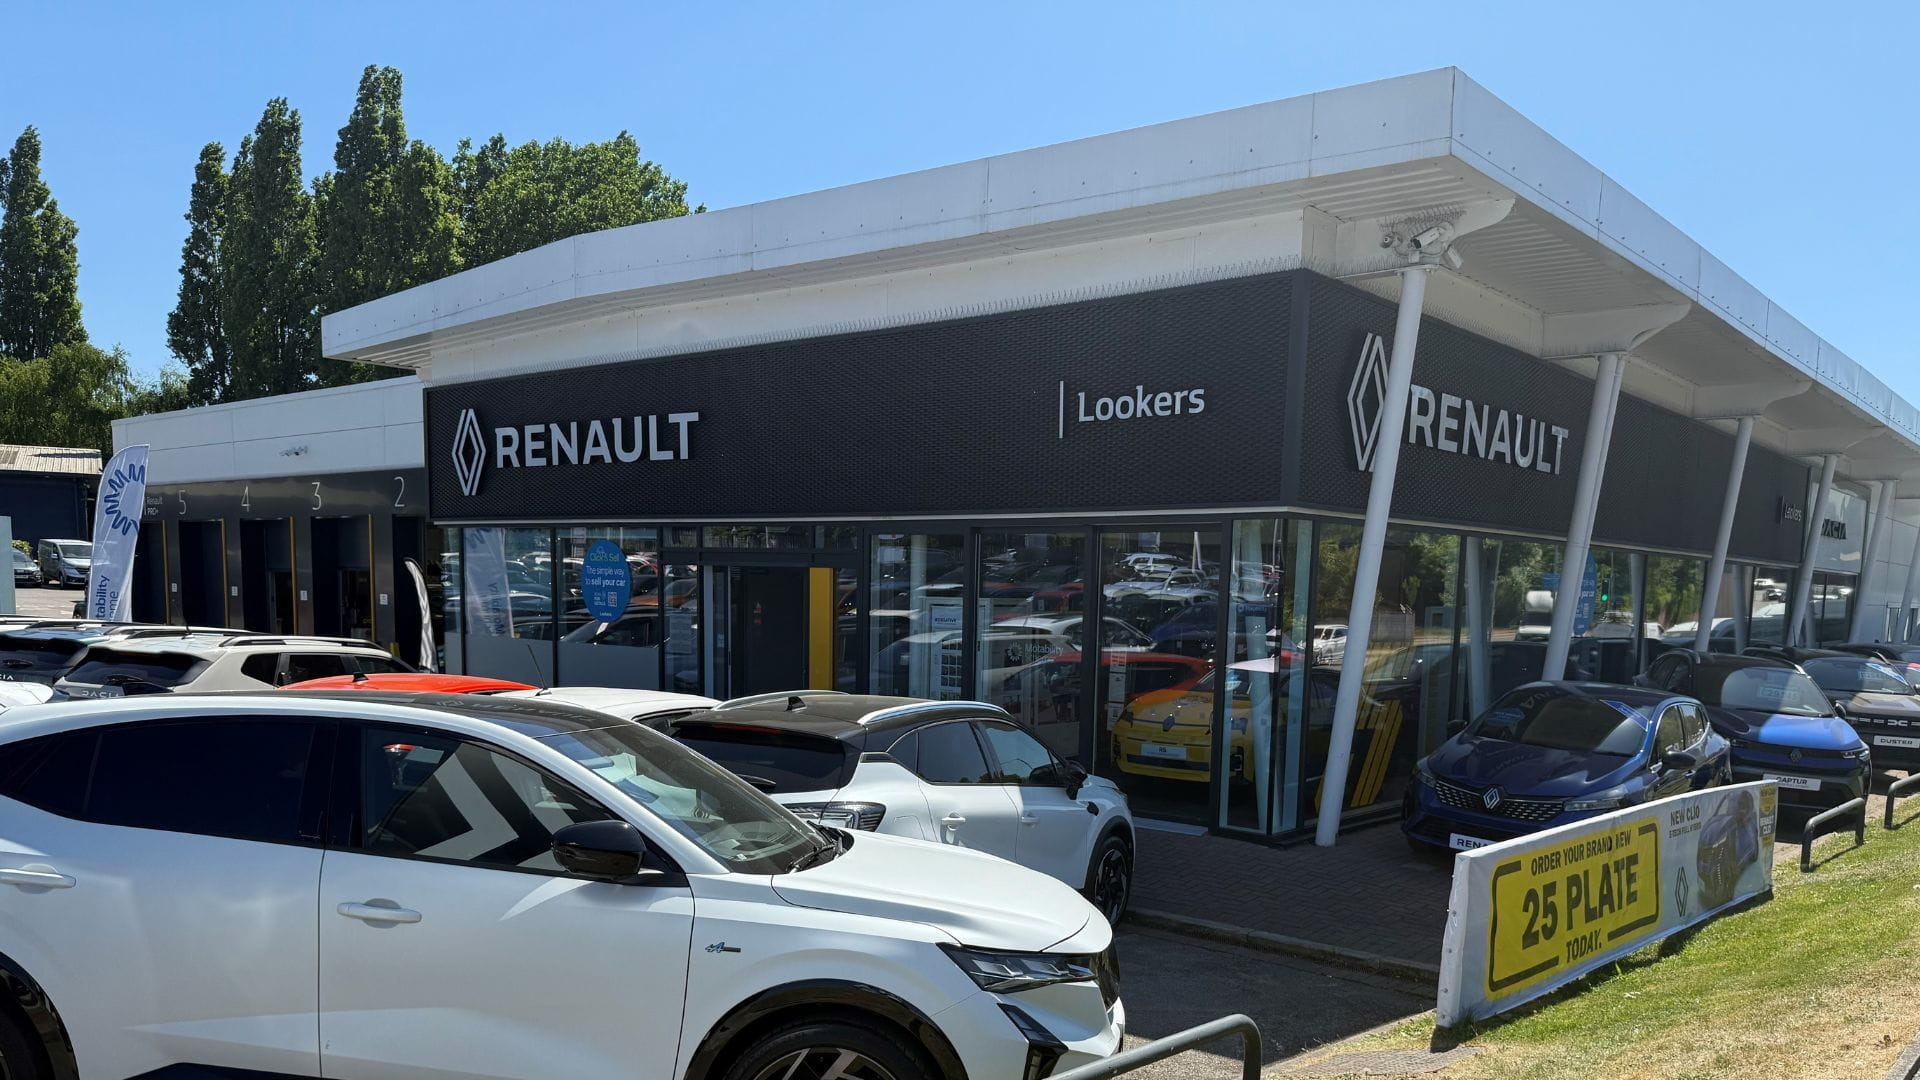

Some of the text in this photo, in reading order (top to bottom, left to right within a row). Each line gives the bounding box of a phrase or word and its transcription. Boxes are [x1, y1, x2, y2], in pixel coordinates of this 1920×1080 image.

[1078, 386, 1205, 423] Lookers
[495, 411, 699, 469] RENAULT
[1408, 384, 1569, 476] RENAULT
[178, 489, 187, 515] 5
[240, 485, 250, 512] 4
[311, 481, 322, 511] 3
[394, 476, 405, 508] 2
[591, 577, 602, 586] sell
[602, 579, 615, 588] your
[1670, 805, 1700, 826] NEW CLIO
[1456, 838, 1488, 849] REN
[1531, 829, 1632, 876] ORDER YOUR BRAND NEW
[1521, 852, 1639, 950] 25 PLATE
[1566, 927, 1603, 963] TODAY.
